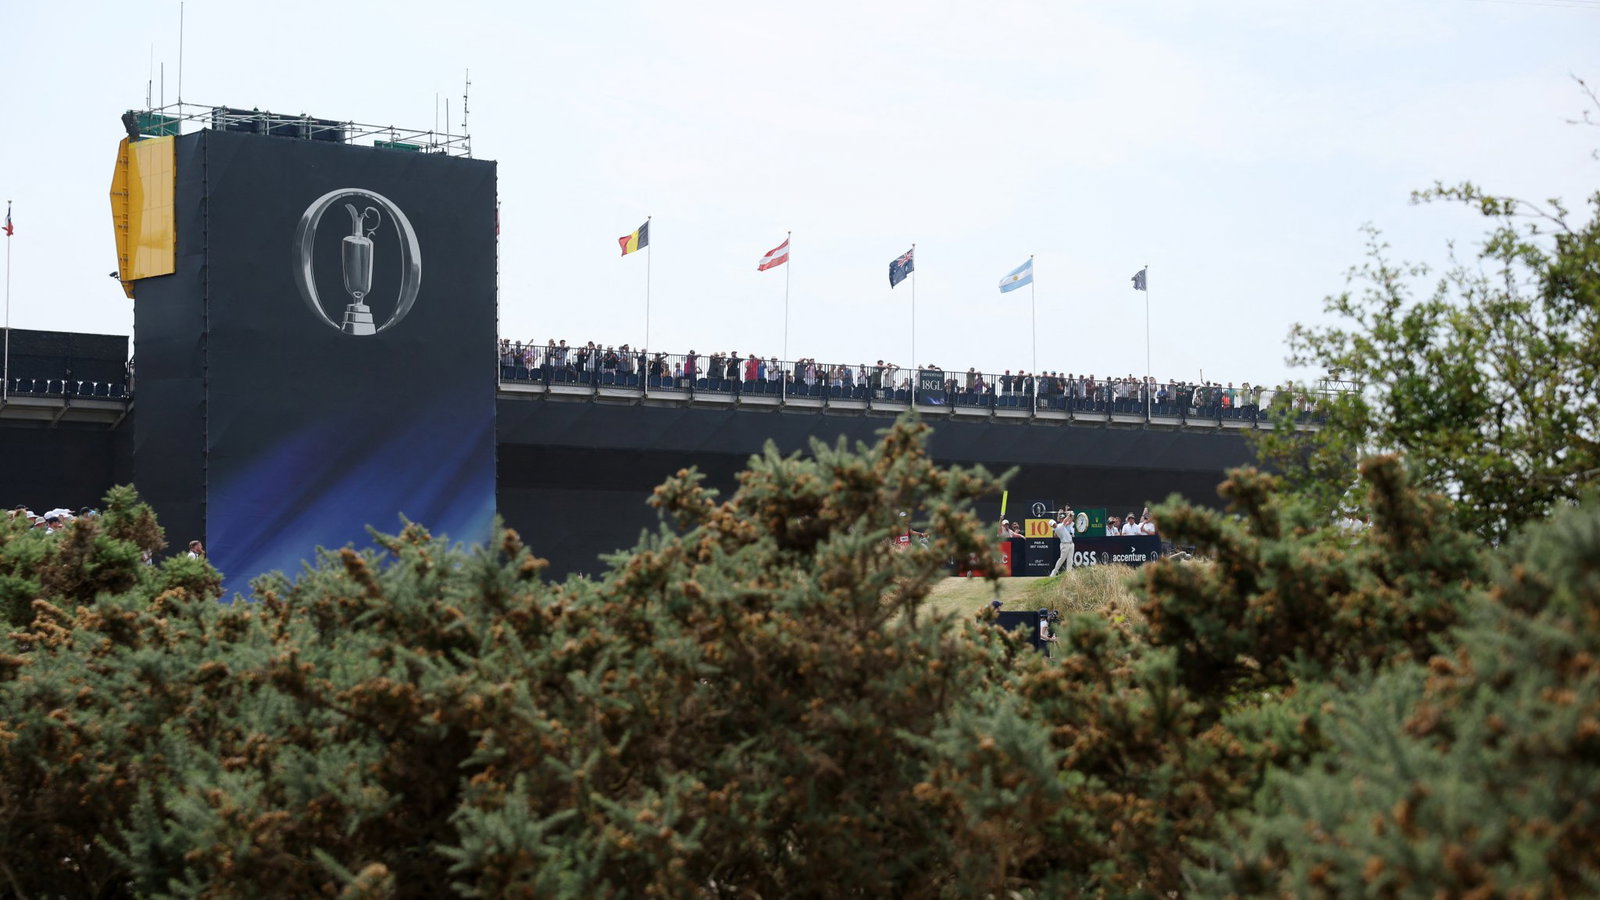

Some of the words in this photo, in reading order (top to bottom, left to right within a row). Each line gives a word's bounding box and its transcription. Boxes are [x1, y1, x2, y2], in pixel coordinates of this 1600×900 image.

[922, 380, 943, 391] 18GL
[1031, 521, 1049, 536] 10
[1074, 551, 1097, 567] OSS
[1112, 553, 1147, 562] accenture
